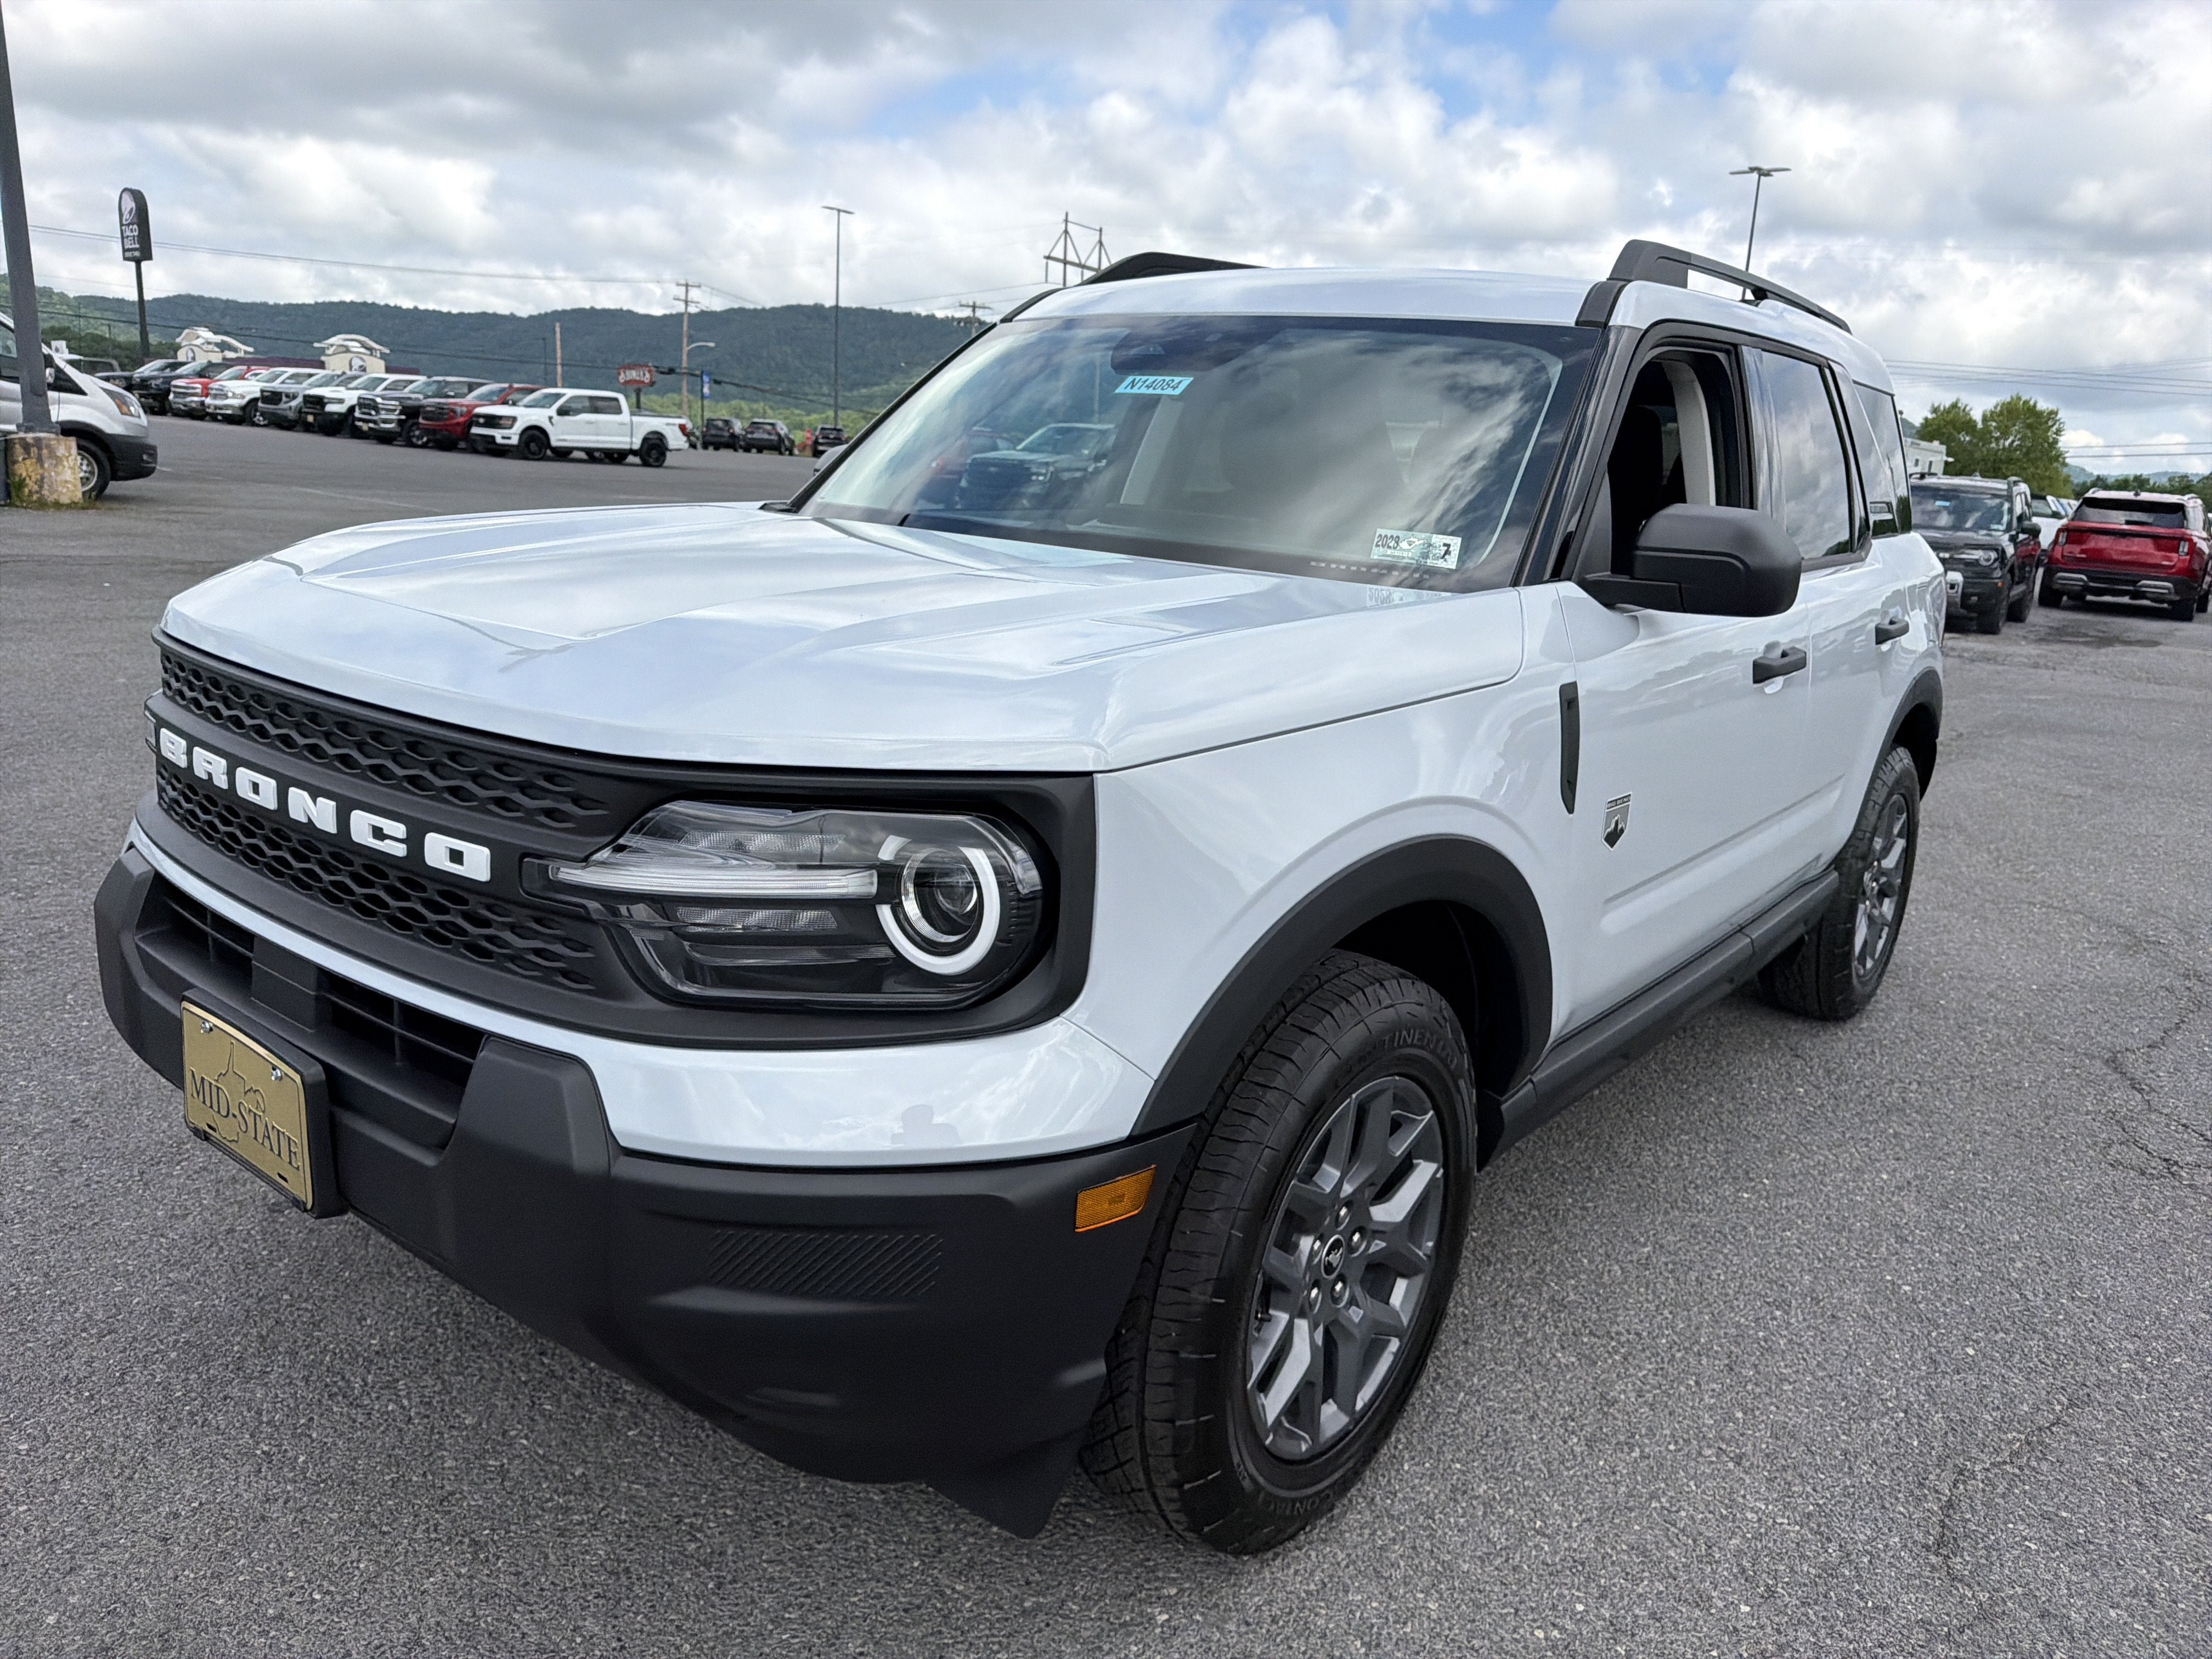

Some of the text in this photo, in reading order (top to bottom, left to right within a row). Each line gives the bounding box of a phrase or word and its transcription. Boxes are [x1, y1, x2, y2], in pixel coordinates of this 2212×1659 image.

[121, 224, 139, 237] TACO
[1124, 377, 1184, 391] N14084
[1374, 534, 1400, 550] 2028
[1440, 542, 1452, 560] 7
[160, 727, 491, 883] BRONCO
[189, 1066, 300, 1171] MID-STATE
